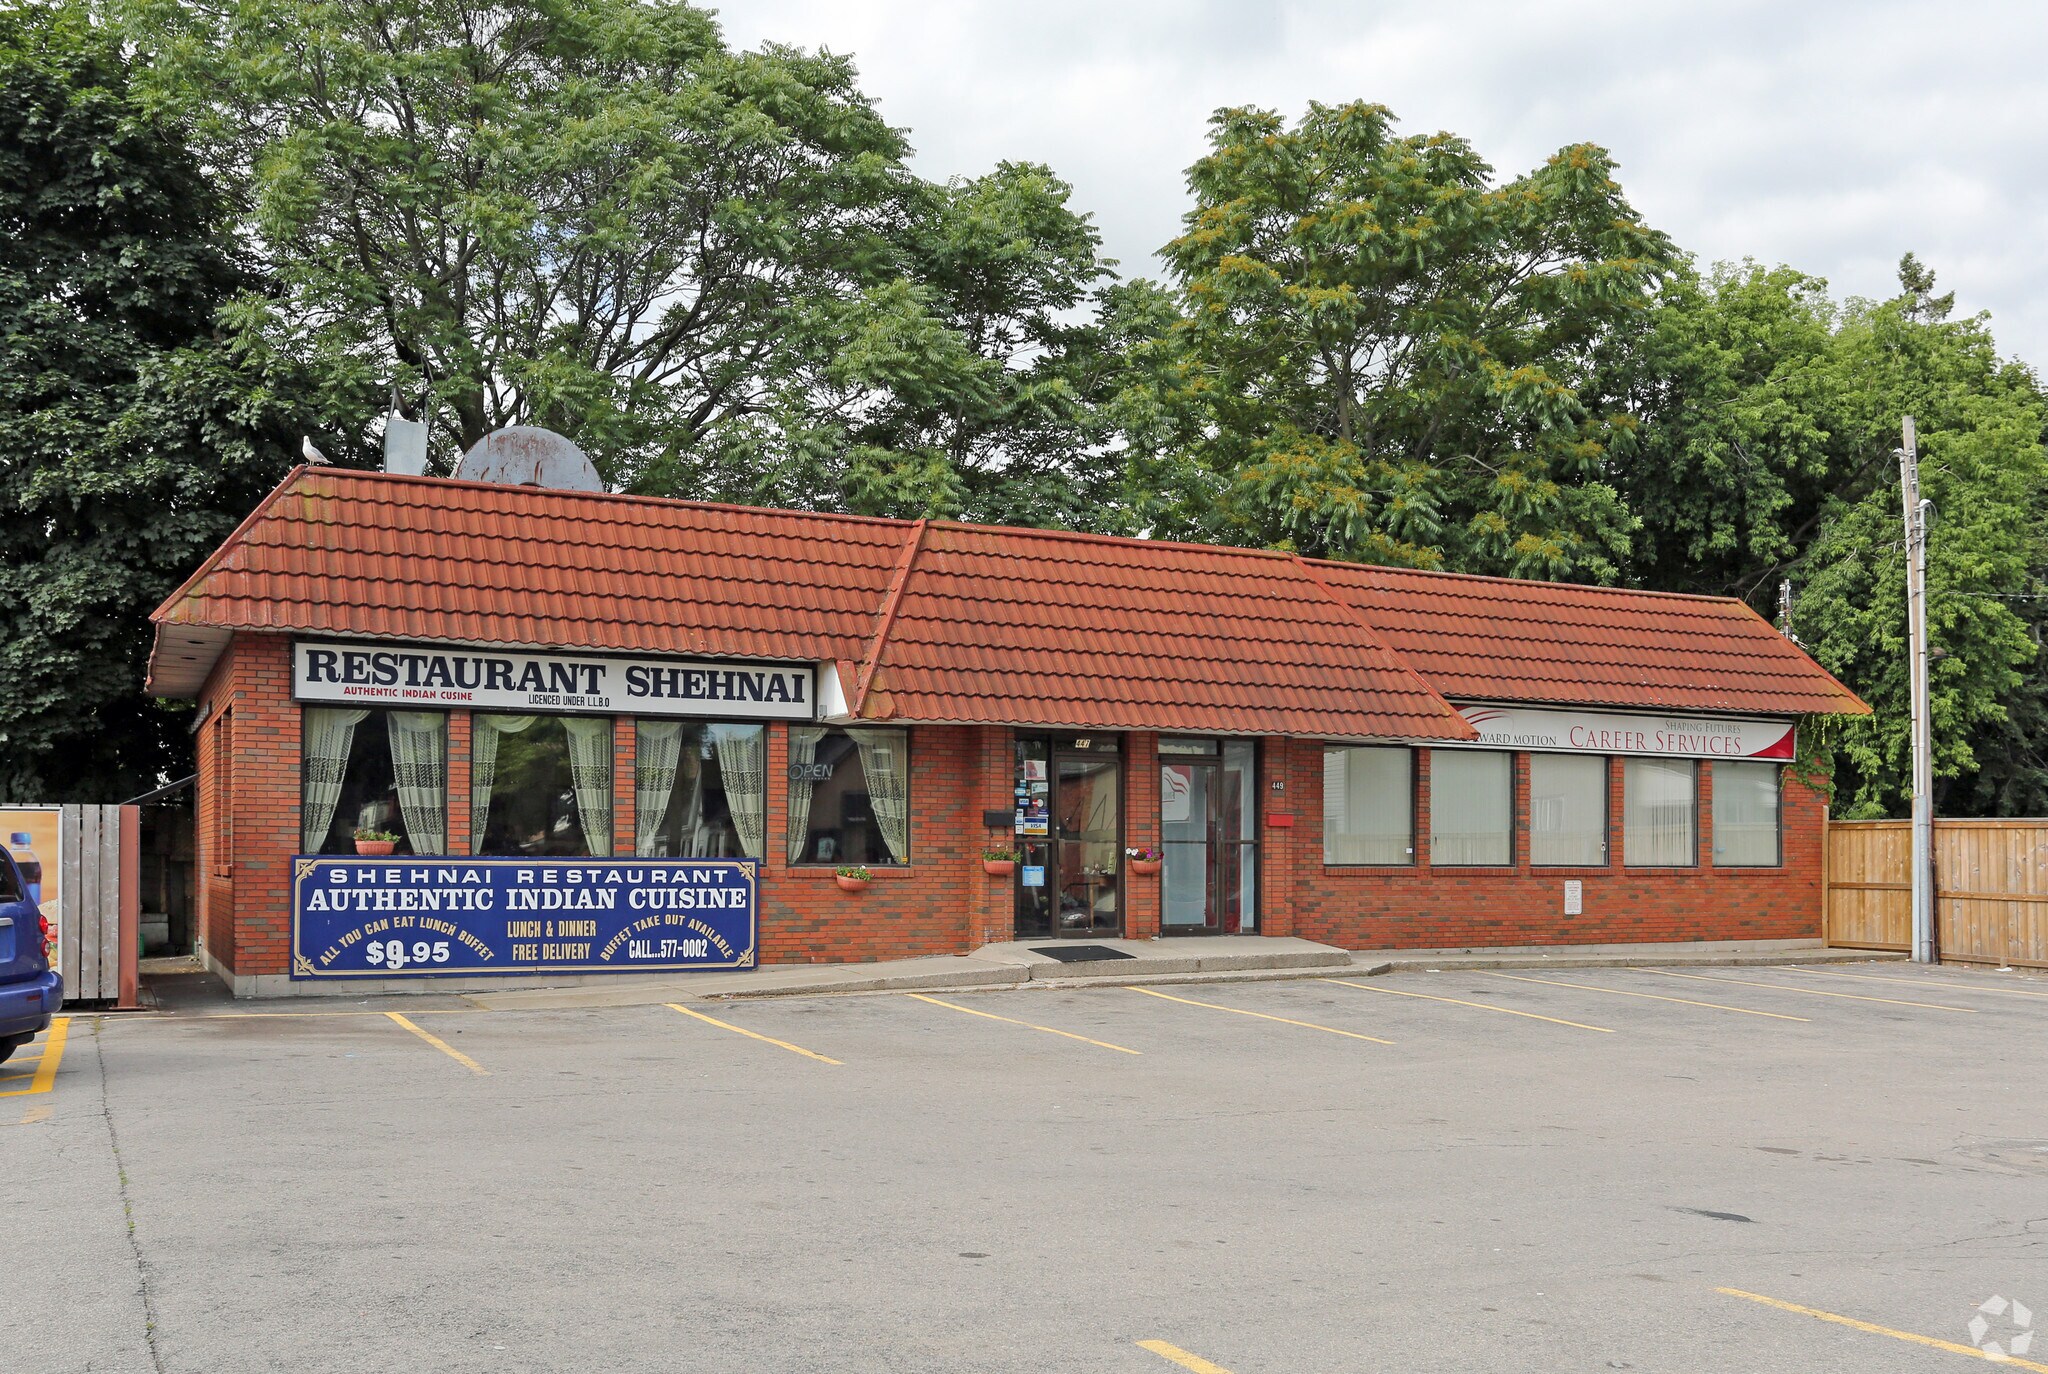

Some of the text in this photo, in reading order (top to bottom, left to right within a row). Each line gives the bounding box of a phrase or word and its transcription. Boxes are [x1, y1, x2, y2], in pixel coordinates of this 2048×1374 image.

[306, 649, 805, 703] RESTAURANT SHEHNAI
[343, 686, 473, 700] AUTHENTIC INDIAN CUSINE
[528, 694, 560, 705] LICENCED
[562, 696, 585, 706] UNDER
[1665, 720, 1741, 733] SHAPING FUTURES
[1075, 739, 1091, 748] 447
[1479, 733, 1557, 746] WARD MOTION
[1569, 726, 1741, 754] CAREER SERVICES
[788, 764, 834, 780] OPEN
[1271, 781, 1284, 791] 449
[329, 869, 728, 884] SHEHNAI RESTAURANT
[306, 888, 746, 911] AUTHENTIC INDIAN CUISINE
[507, 920, 597, 938] LUNCH & DINNER
[319, 916, 495, 966] ALL YOU CAN EAT LUNCH BUFFET
[600, 914, 734, 962] BUFFET TAKE OUT AVAILABLE
[365, 939, 450, 970] $9.95
[512, 943, 591, 961] FREE DELIVERY
